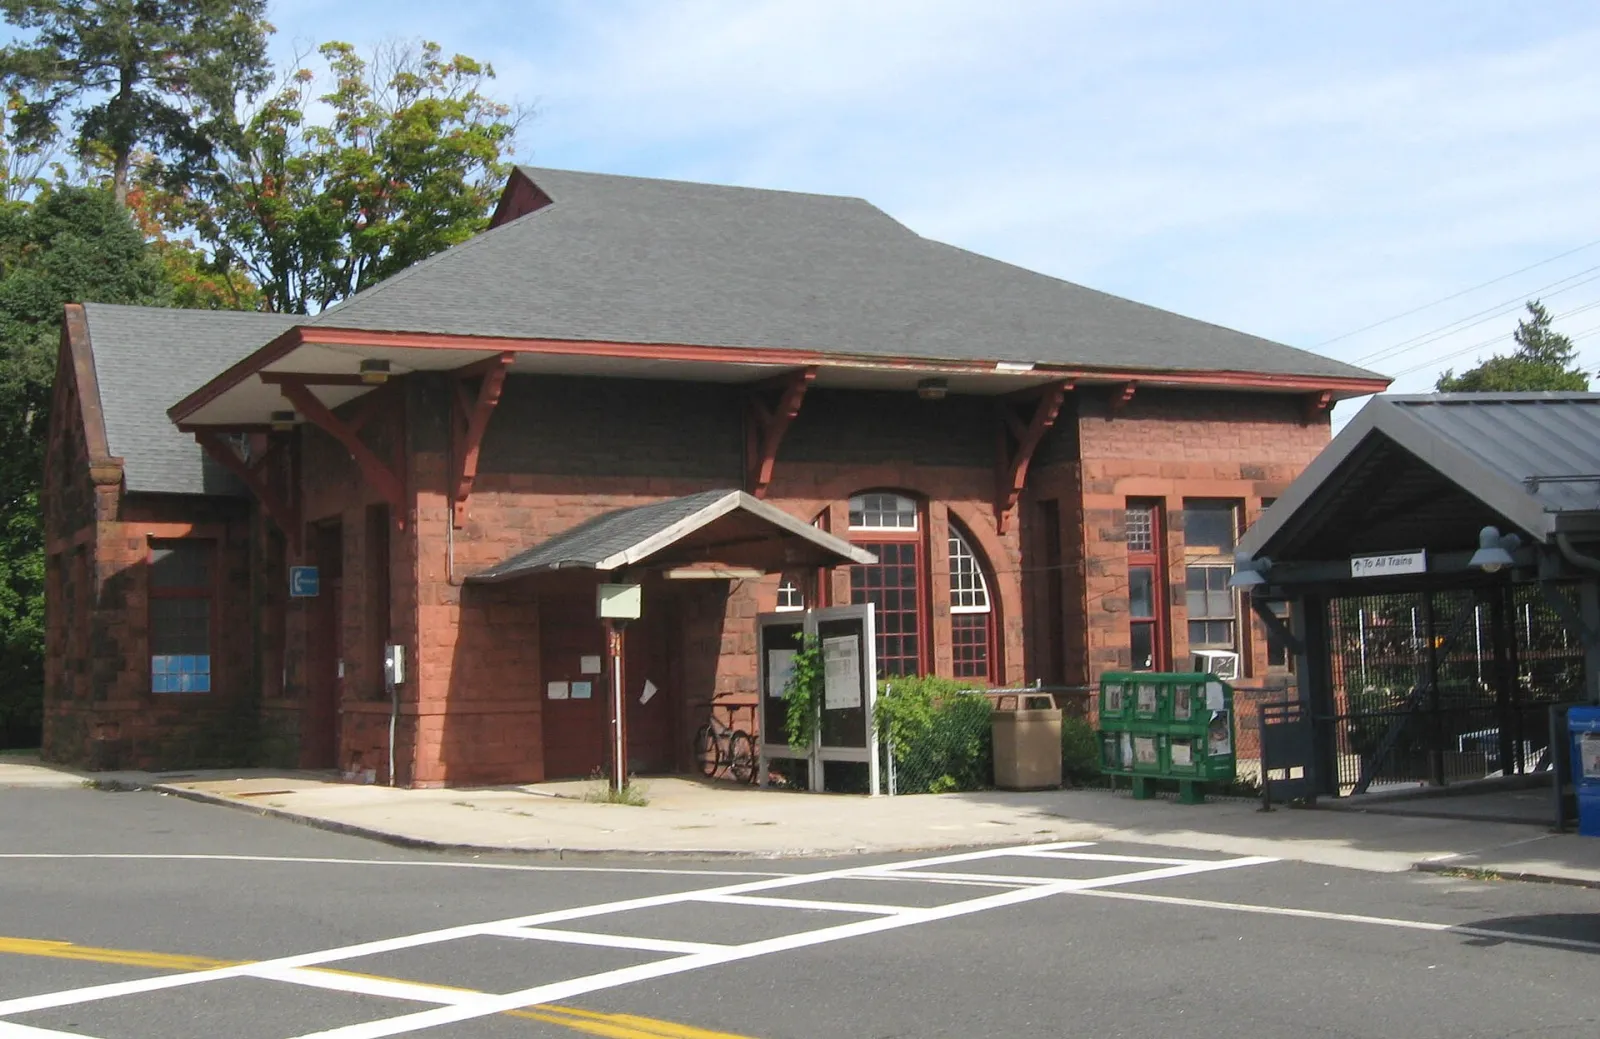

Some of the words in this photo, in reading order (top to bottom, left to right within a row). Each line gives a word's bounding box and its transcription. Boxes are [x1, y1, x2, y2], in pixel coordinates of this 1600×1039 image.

[1364, 559, 1373, 568] To
[1375, 558, 1386, 567] All
[1388, 556, 1413, 566] Trains
